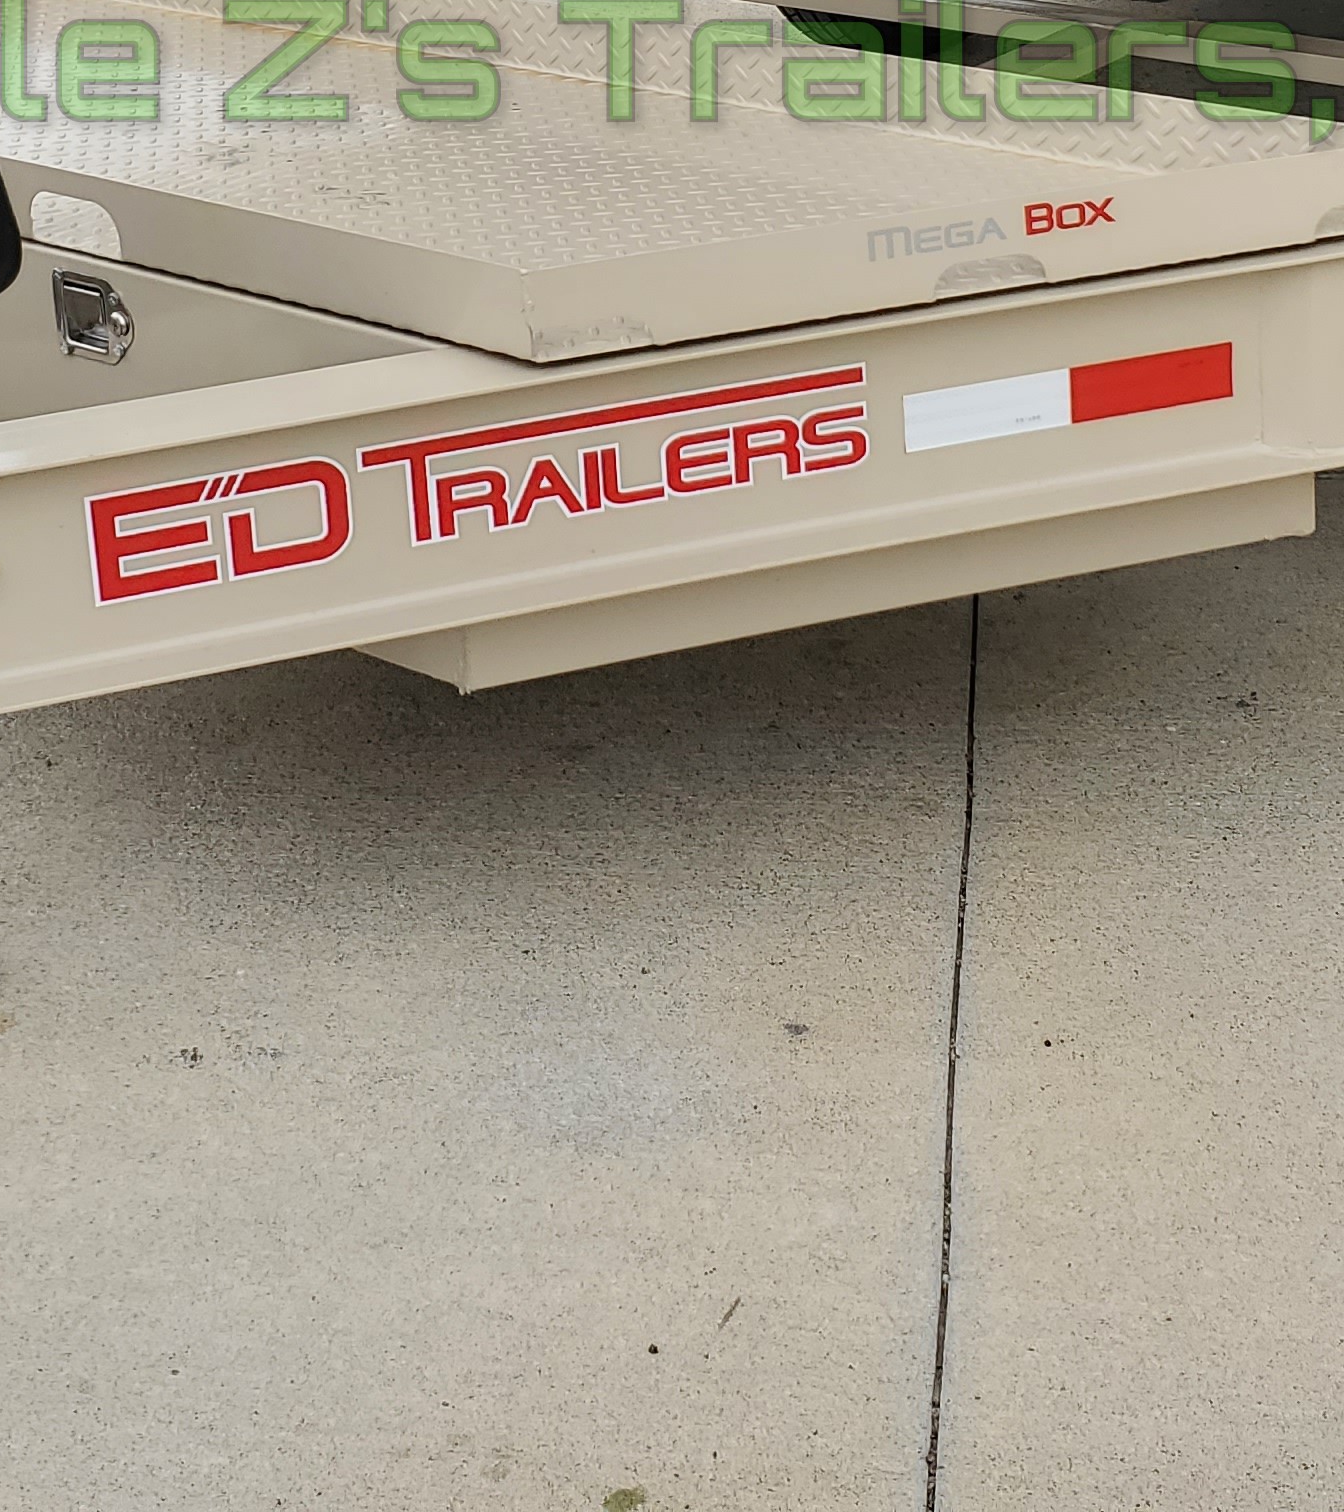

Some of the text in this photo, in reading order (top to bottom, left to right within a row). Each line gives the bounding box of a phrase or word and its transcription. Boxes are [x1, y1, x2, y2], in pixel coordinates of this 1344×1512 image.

[866, 197, 1116, 262] MEGA BOX
[356, 362, 868, 547] TRAILERS
